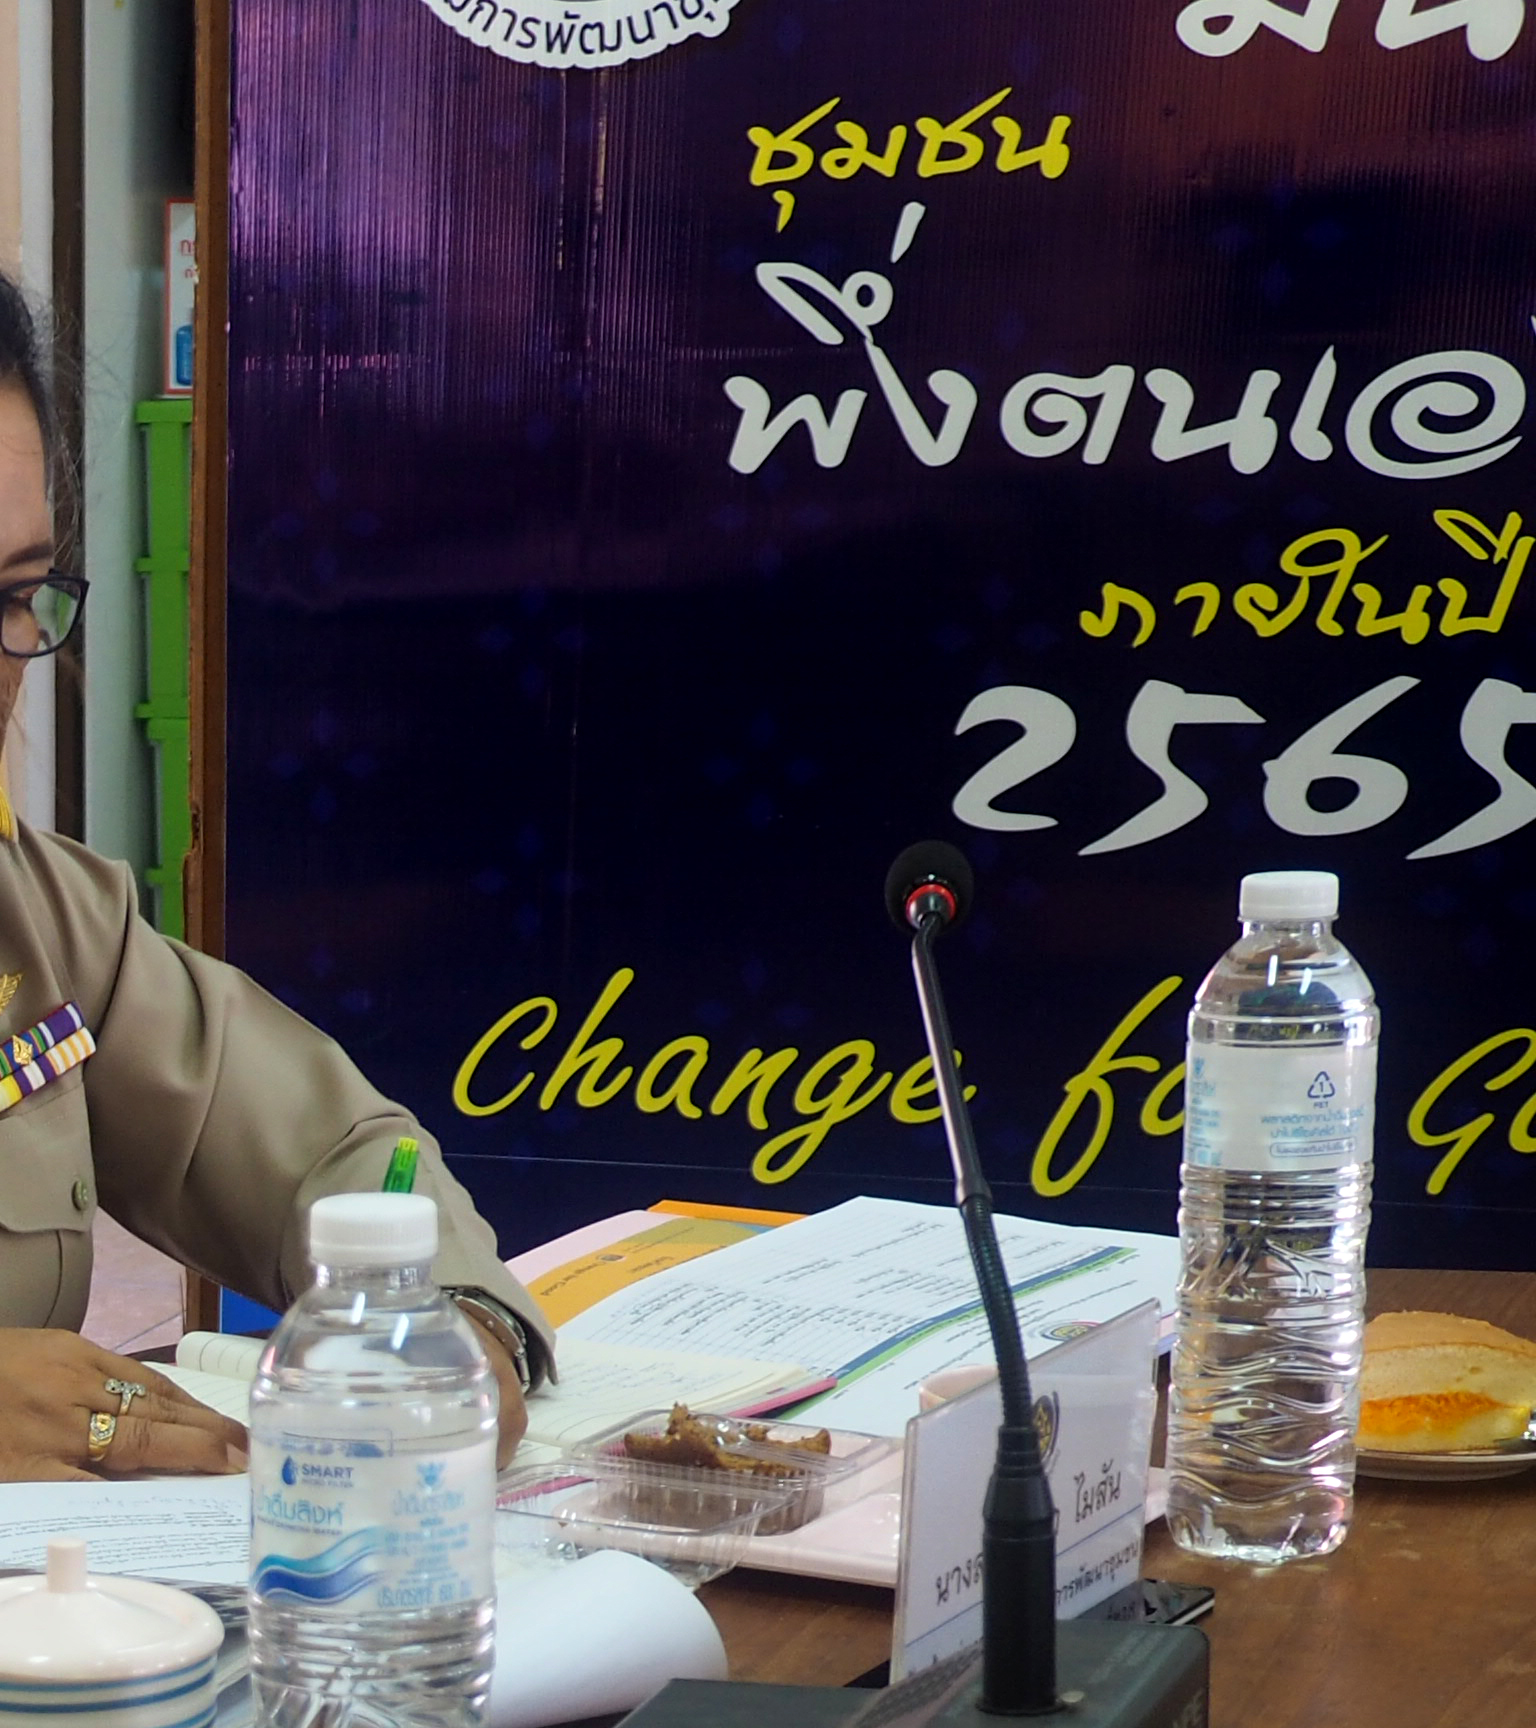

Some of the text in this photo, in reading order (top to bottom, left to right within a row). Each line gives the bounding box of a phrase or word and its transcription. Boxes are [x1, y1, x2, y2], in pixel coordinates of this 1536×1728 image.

[748, 88, 1070, 231] ชุมชน
[725, 203, 1536, 480] พึ่งตนเอ
[1080, 510, 1536, 647] ภายในปี
[952, 675, 1536, 859] 2565
[452, 966, 977, 1184] Change
[1031, 976, 1186, 1196] fo
[301, 1463, 354, 1479] SMART
